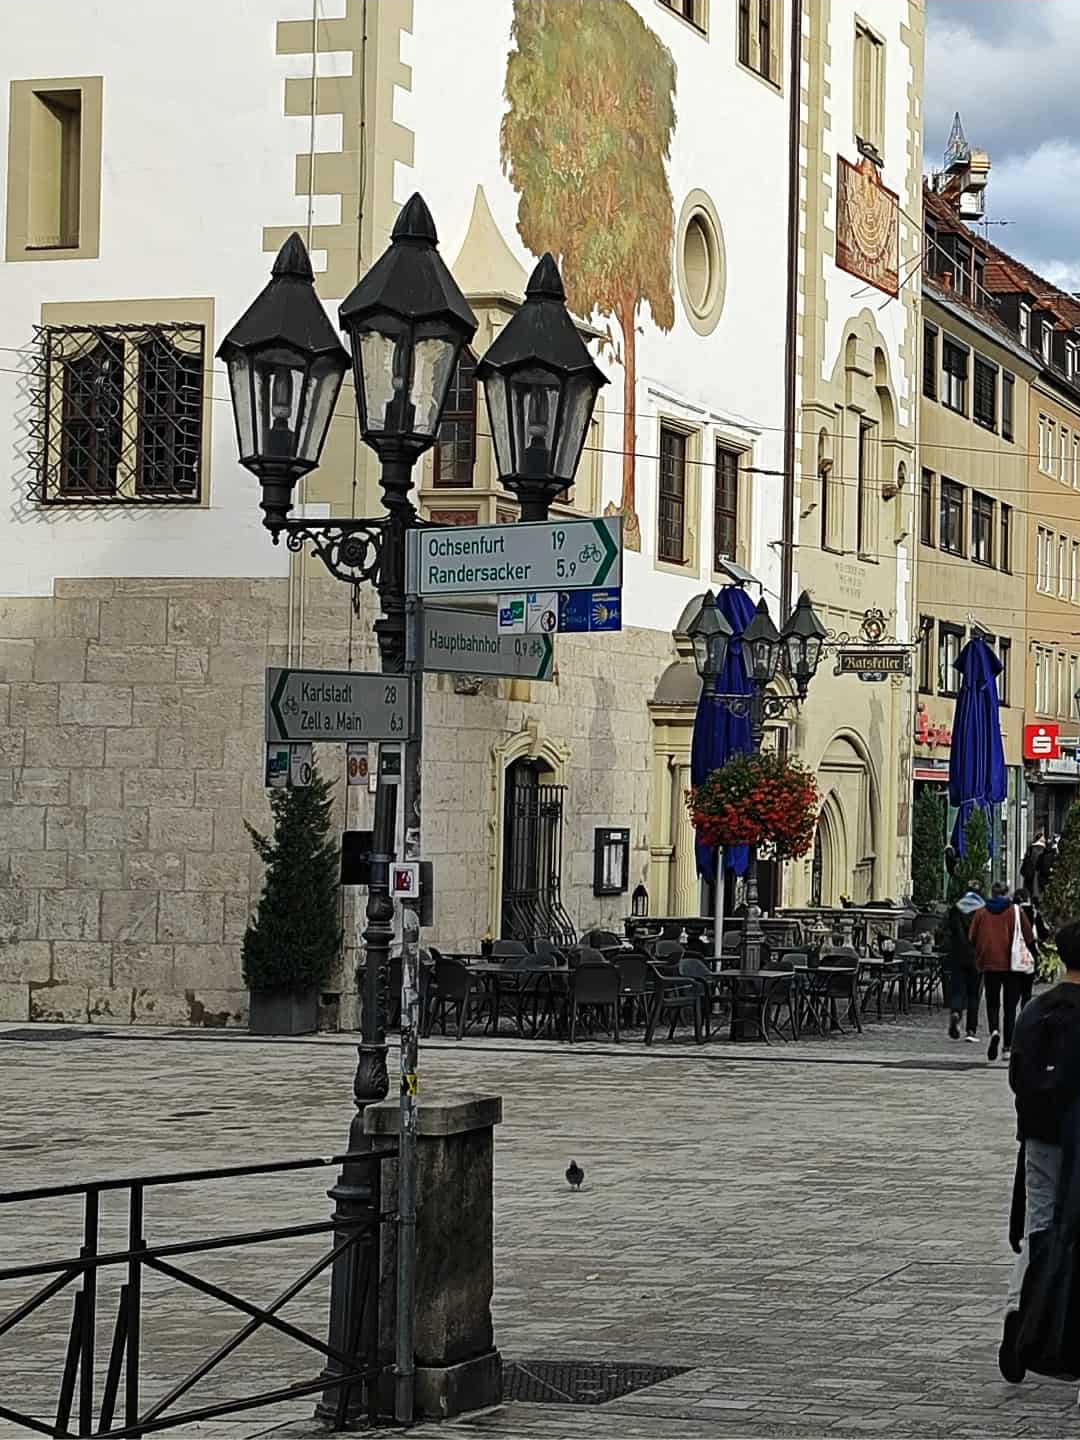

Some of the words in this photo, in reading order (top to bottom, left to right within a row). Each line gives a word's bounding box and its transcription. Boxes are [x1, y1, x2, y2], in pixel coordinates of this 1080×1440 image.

[428, 536, 506, 558] Ochsenfurt
[551, 531, 566, 550] 19
[428, 561, 532, 585] Randersacker
[556, 560, 577, 578] 5,9
[429, 631, 501, 656] Hauptbahnhof
[301, 682, 352, 703] Karlstadt
[384, 686, 397, 704] 28
[301, 711, 321, 730] Zell
[324, 716, 333, 730] a.
[336, 712, 362, 731] Main
